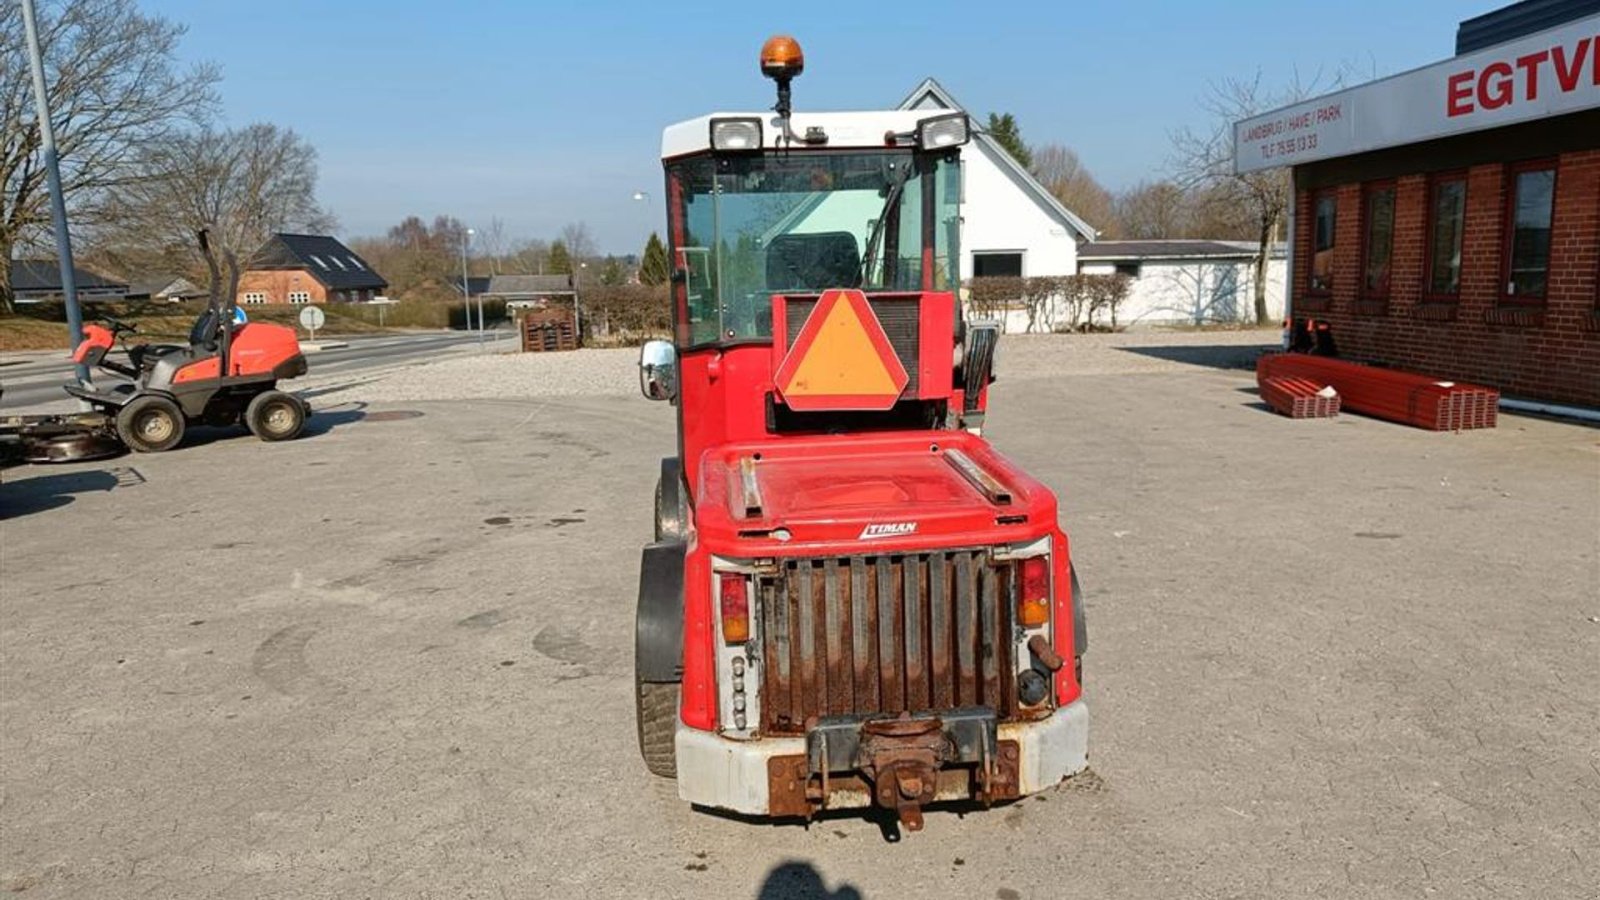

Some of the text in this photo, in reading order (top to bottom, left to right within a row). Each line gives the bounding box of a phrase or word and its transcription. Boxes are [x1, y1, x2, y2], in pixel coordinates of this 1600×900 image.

[1243, 120, 1282, 142] LANDBRUG
[1289, 112, 1311, 130] HAVE
[1317, 103, 1342, 123] PARK
[867, 522, 918, 535] TIMAN
